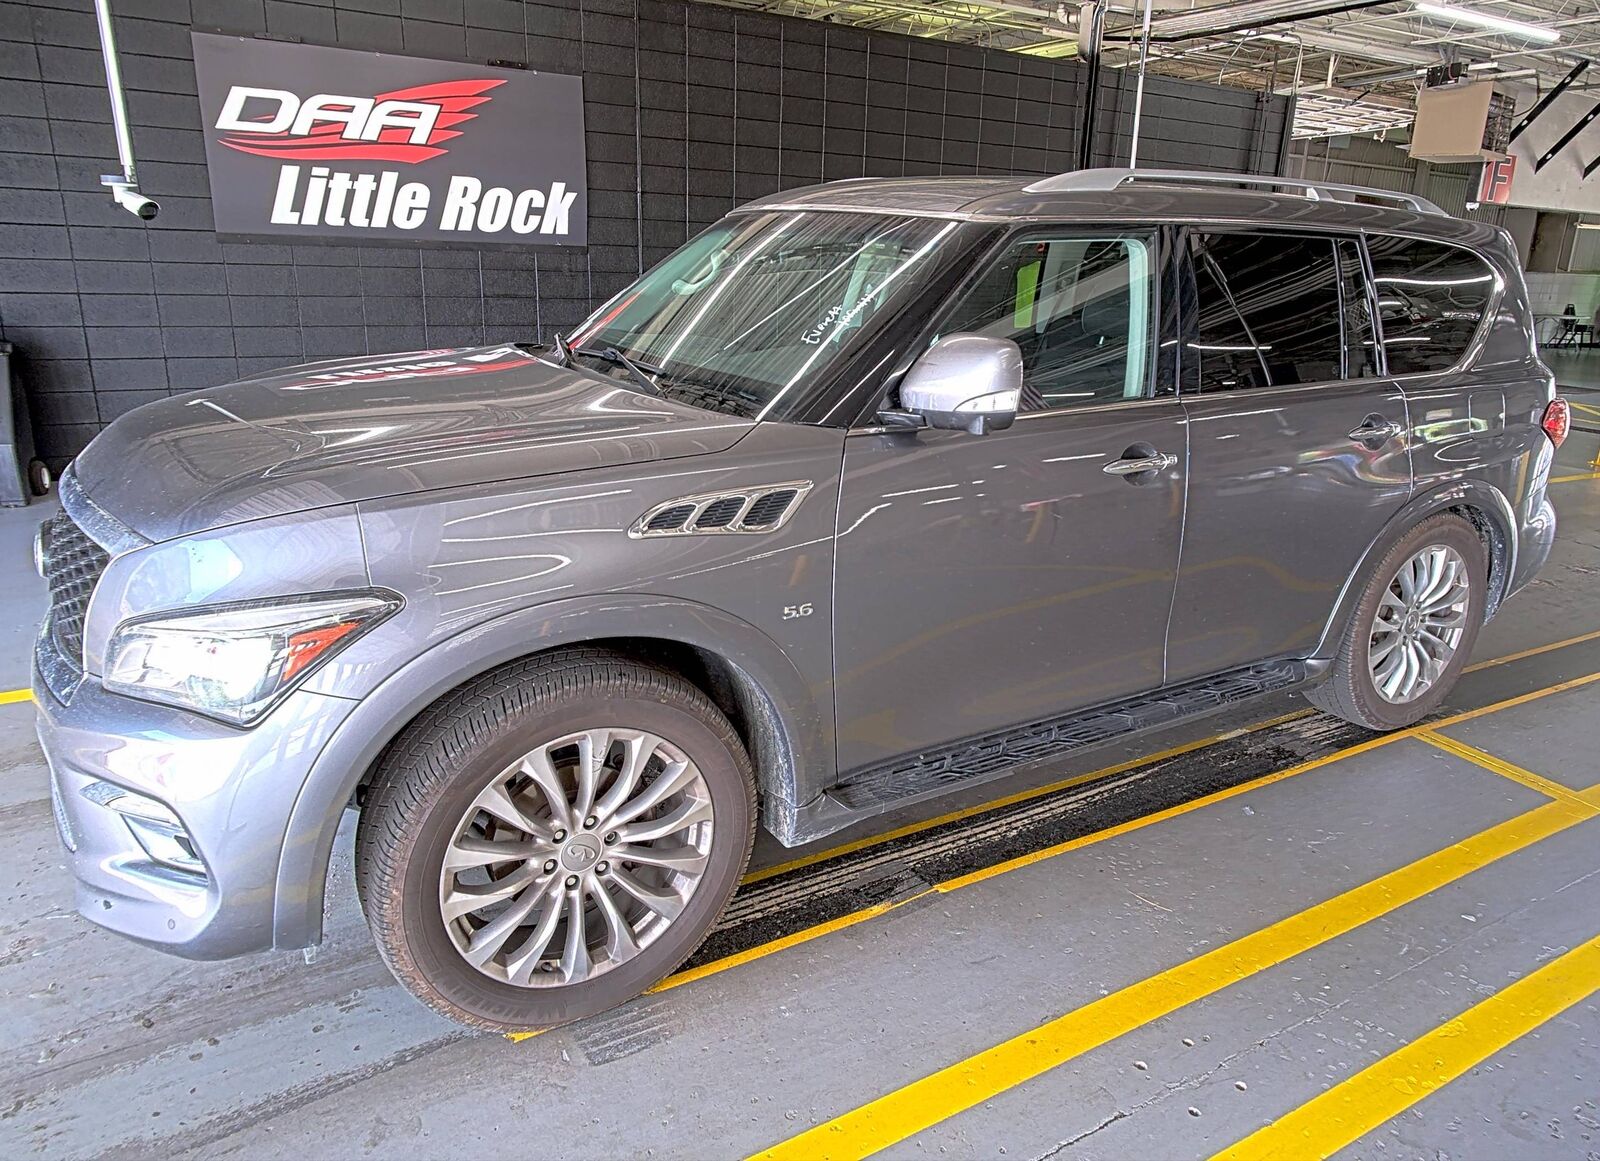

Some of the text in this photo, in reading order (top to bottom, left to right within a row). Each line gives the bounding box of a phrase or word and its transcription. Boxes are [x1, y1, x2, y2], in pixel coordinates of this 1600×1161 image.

[215, 86, 441, 144] DAA
[270, 164, 578, 235] Little Rock
[782, 603, 814, 620] 5.6
